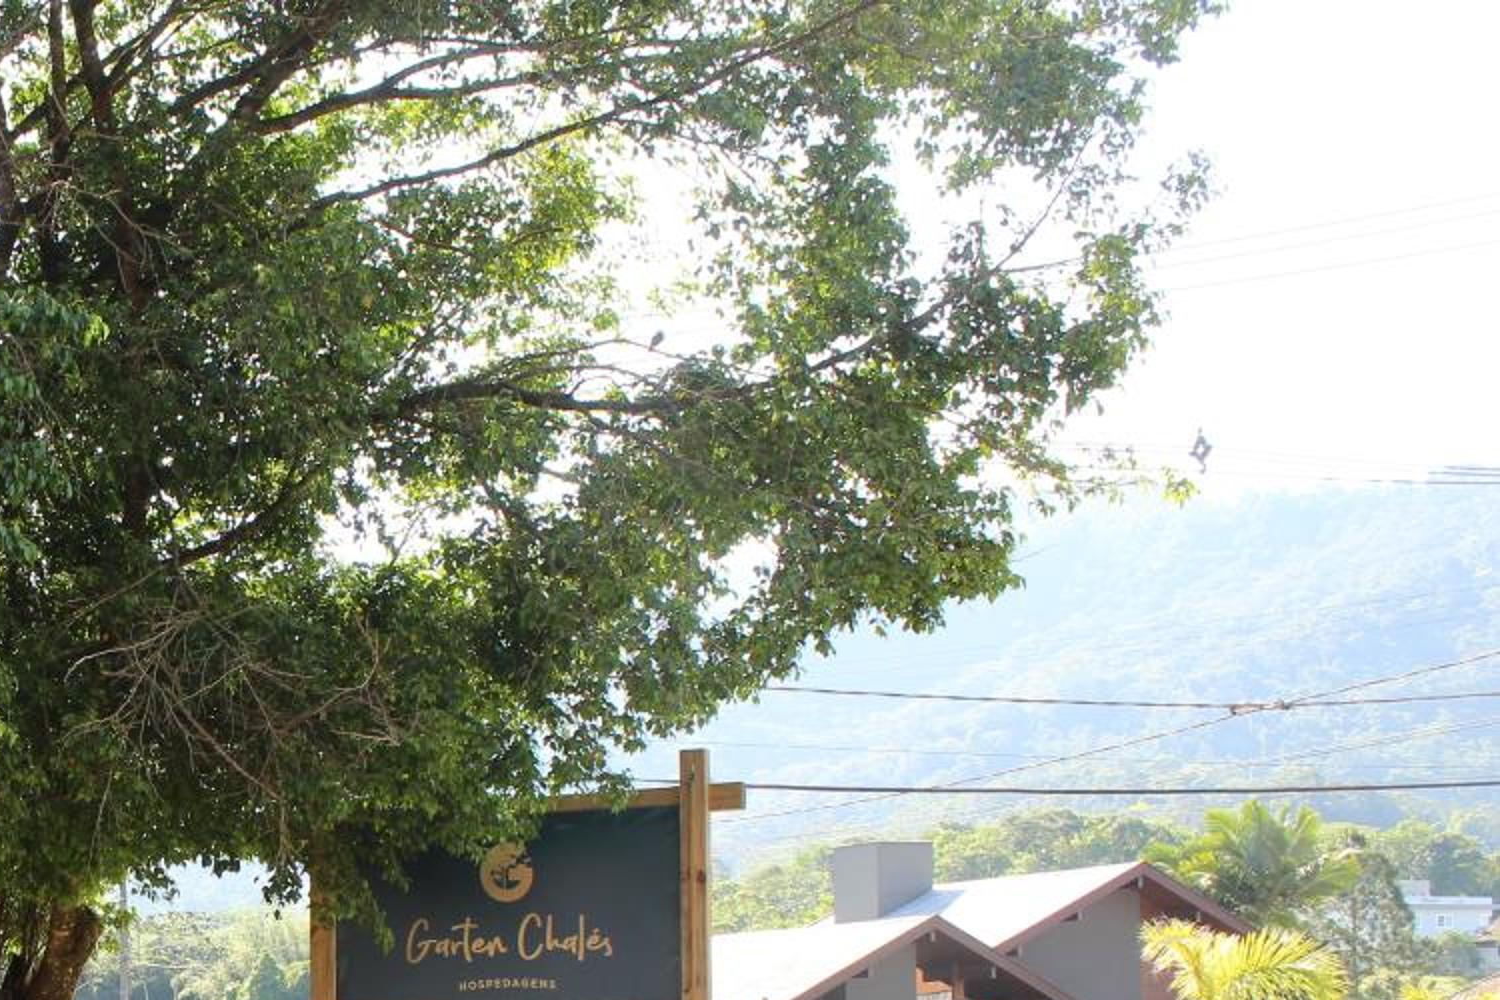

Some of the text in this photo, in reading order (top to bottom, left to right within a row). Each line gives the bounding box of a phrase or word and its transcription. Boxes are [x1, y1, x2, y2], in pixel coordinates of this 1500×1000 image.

[406, 912, 613, 964] Garten Chalés
[459, 977, 557, 991] HOSPEDAGENS
